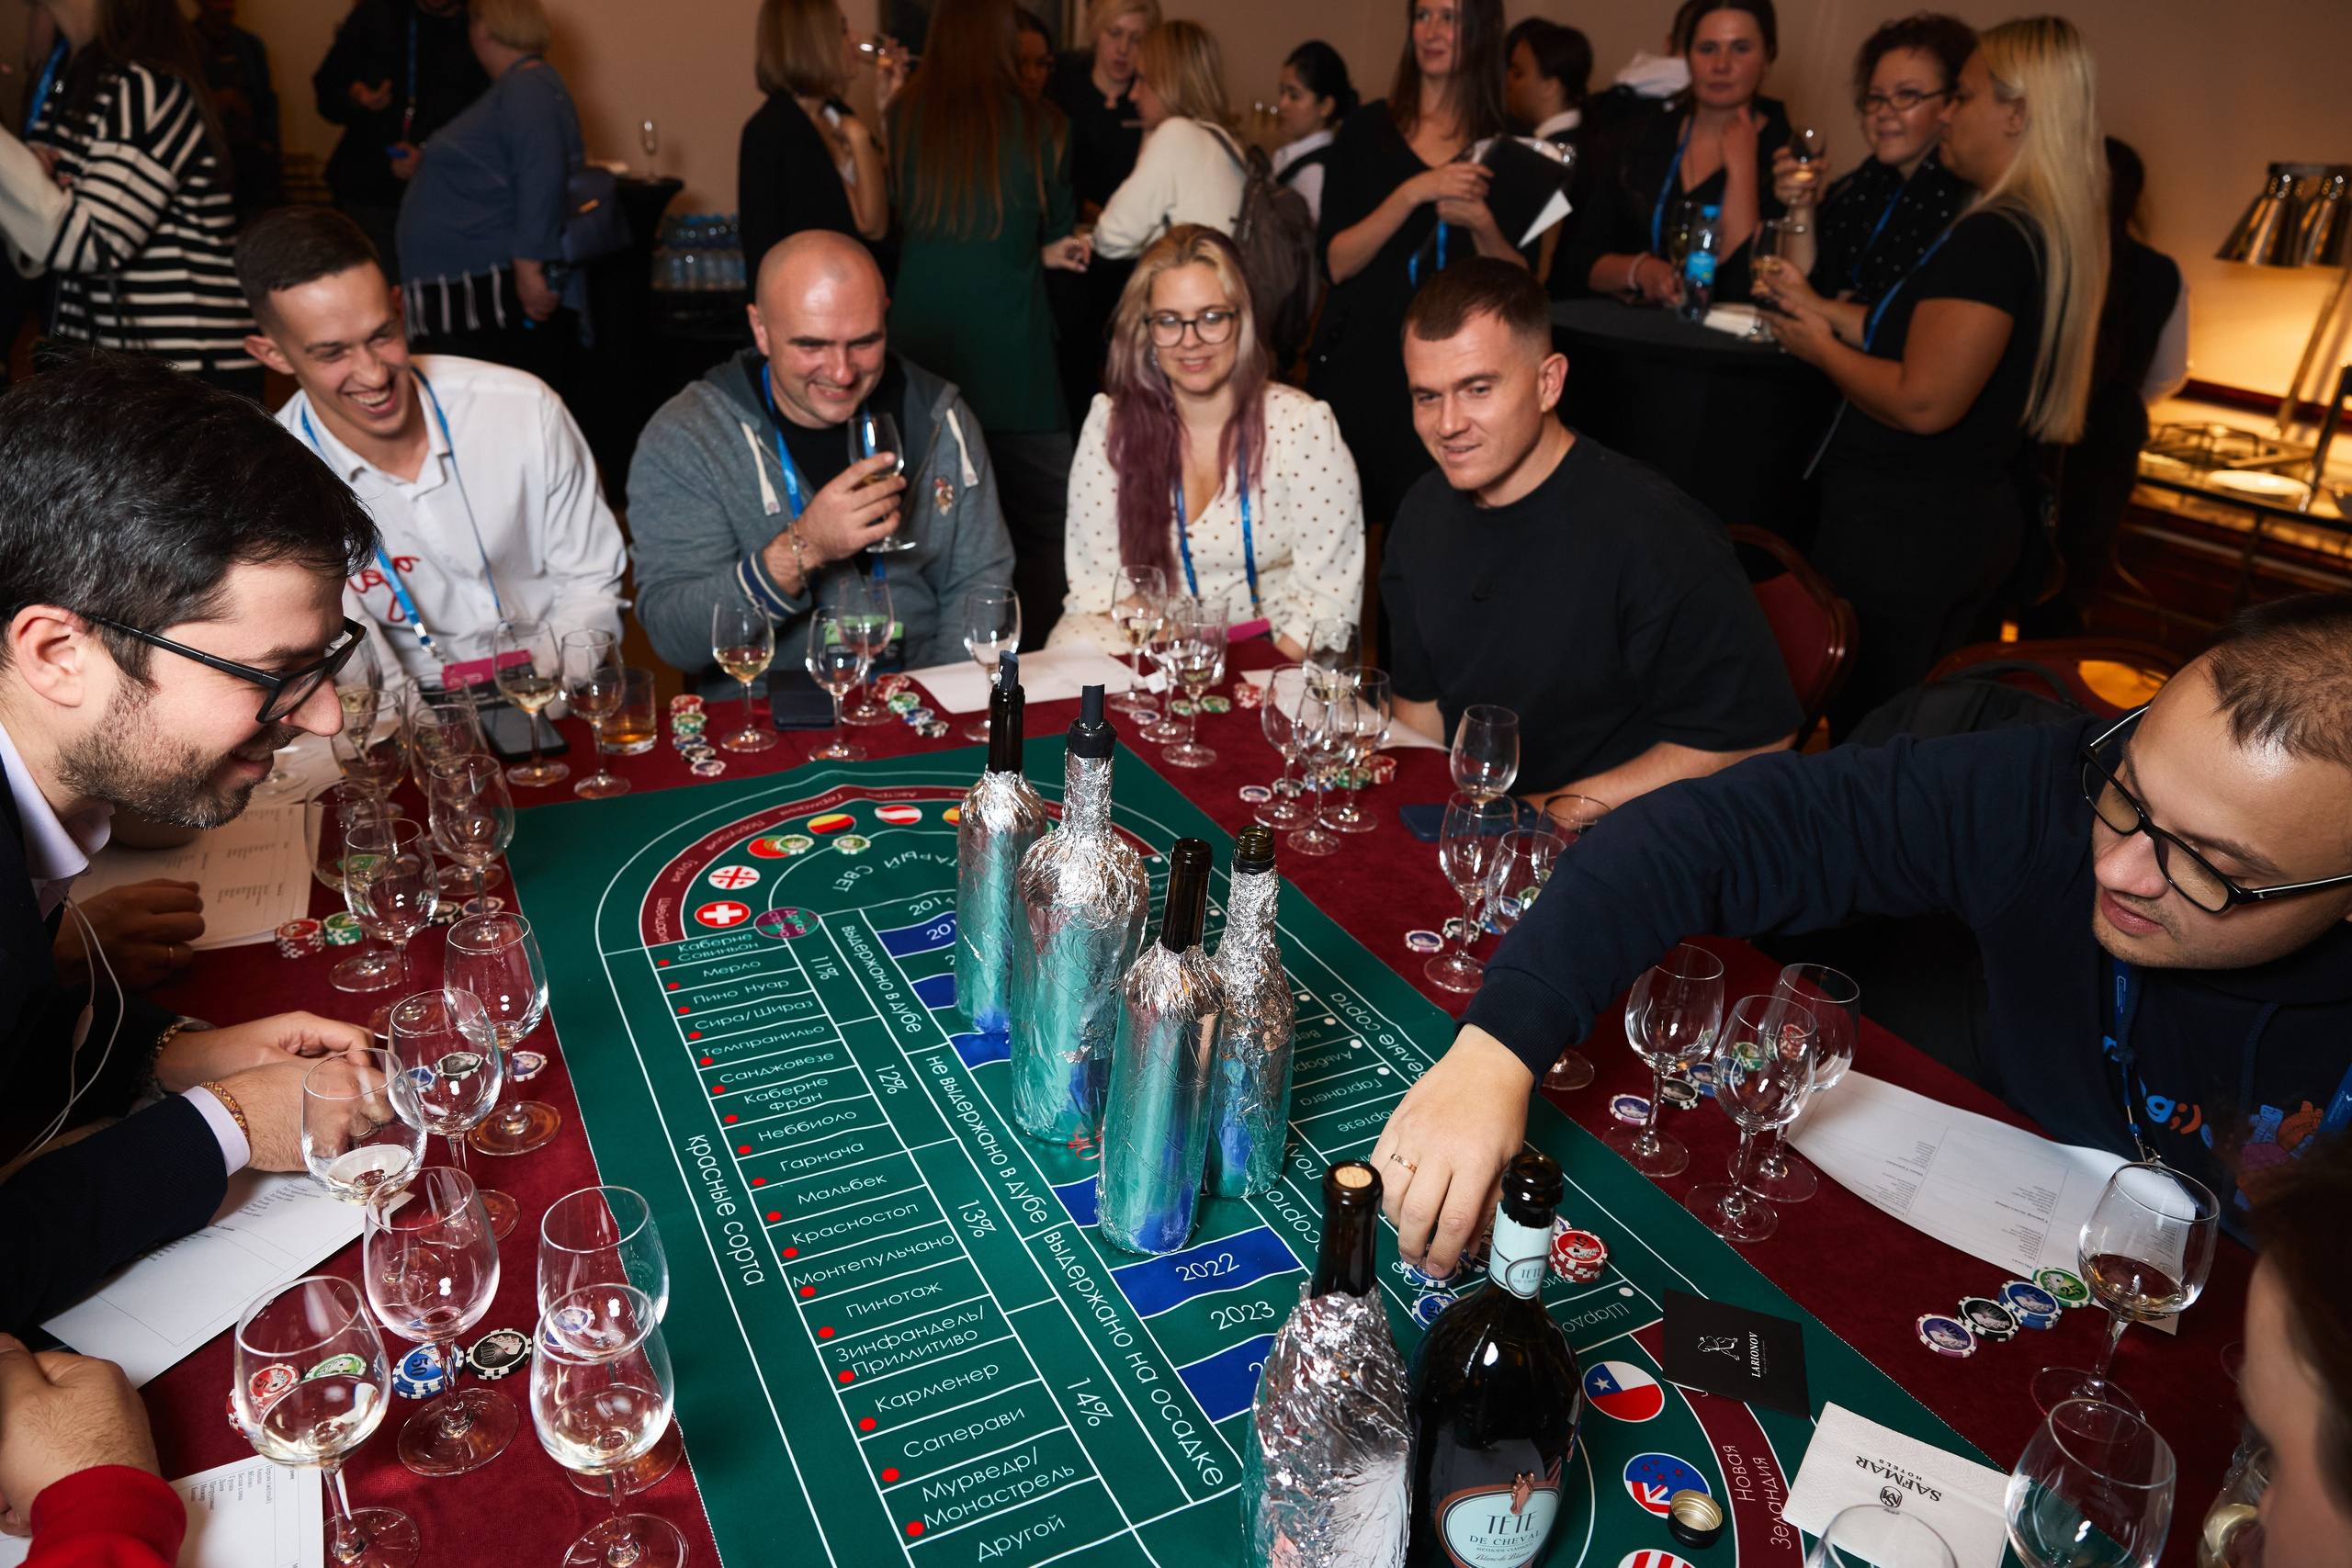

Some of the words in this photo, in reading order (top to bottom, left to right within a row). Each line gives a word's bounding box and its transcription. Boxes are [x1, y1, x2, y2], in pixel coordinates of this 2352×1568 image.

[884, 850, 957, 870] ТАРЫЙ
[832, 865, 874, 892] СВЕТ
[678, 933, 752, 953] Каберне
[678, 942, 759, 963] Совиньон
[703, 961, 761, 977] Мерло
[810, 955, 840, 980] 11%
[841, 925, 894, 992] выдержано
[888, 1001, 922, 1033] дубе
[693, 989, 739, 1005] Пино
[744, 979, 789, 994] Нуар
[1329, 992, 1381, 1032] сорта
[701, 1025, 825, 1057] Темпранильо
[719, 1053, 834, 1084] Санджовезе
[876, 1064, 909, 1094] 12%
[926, 1055, 948, 1075] не
[744, 1077, 829, 1104] Каберне
[1299, 1077, 1383, 1106] Гарганега
[758, 1111, 857, 1142] Неббиоло
[939, 1077, 1008, 1166] выдержано
[779, 1142, 865, 1172] Гарнача
[1000, 1167, 1017, 1179] в
[797, 1175, 888, 1205] Мальбек
[1004, 1181, 1047, 1224] дубе
[685, 1134, 736, 1217] красные
[724, 1221, 765, 1285] сорта
[791, 1203, 919, 1245] Красностоп
[958, 1200, 997, 1238] 13%
[792, 1235, 955, 1288] Монтепульчано
[1175, 1253, 1240, 1281] 2022
[845, 1281, 944, 1318] Пинотаж
[2022, 1286, 2047, 1303] 50
[2060, 1284, 2084, 1297] 25
[1210, 1301, 1275, 1331] 2023
[1426, 1303, 1442, 1319] 50
[1562, 1302, 1630, 1333] Шардо
[1978, 1302, 2007, 1320] 100
[835, 1304, 984, 1362] Зинфандель/
[1939, 1320, 1963, 1340] 500
[410, 1357, 427, 1378] 50
[480, 1344, 497, 1365] 100
[852, 1330, 978, 1377] Примитиво
[1043, 1231, 1134, 1348] выдержано
[1125, 1351, 1159, 1384] на
[1150, 1389, 1224, 1486] осадке
[1750, 1331, 1759, 1378] LARIONOV
[875, 1363, 1000, 1413] Карменер
[1067, 1377, 1114, 1427] 14%
[903, 1407, 1025, 1458] Саперави
[922, 1446, 1038, 1503] Мурведр/
[1722, 1444, 1755, 1502] Новая
[1855, 1455, 1942, 1502] SAFMAR
[1879, 1459, 1923, 1482] HOTELS
[923, 1465, 1075, 1529] Монастрель
[1760, 1457, 1792, 1551] Зеландия
[1469, 1535, 1487, 1544] DE
[1493, 1530, 1541, 1545] CHEVAL
[1487, 1510, 1538, 1535] TÊTE
[978, 1515, 1066, 1562] Другой
